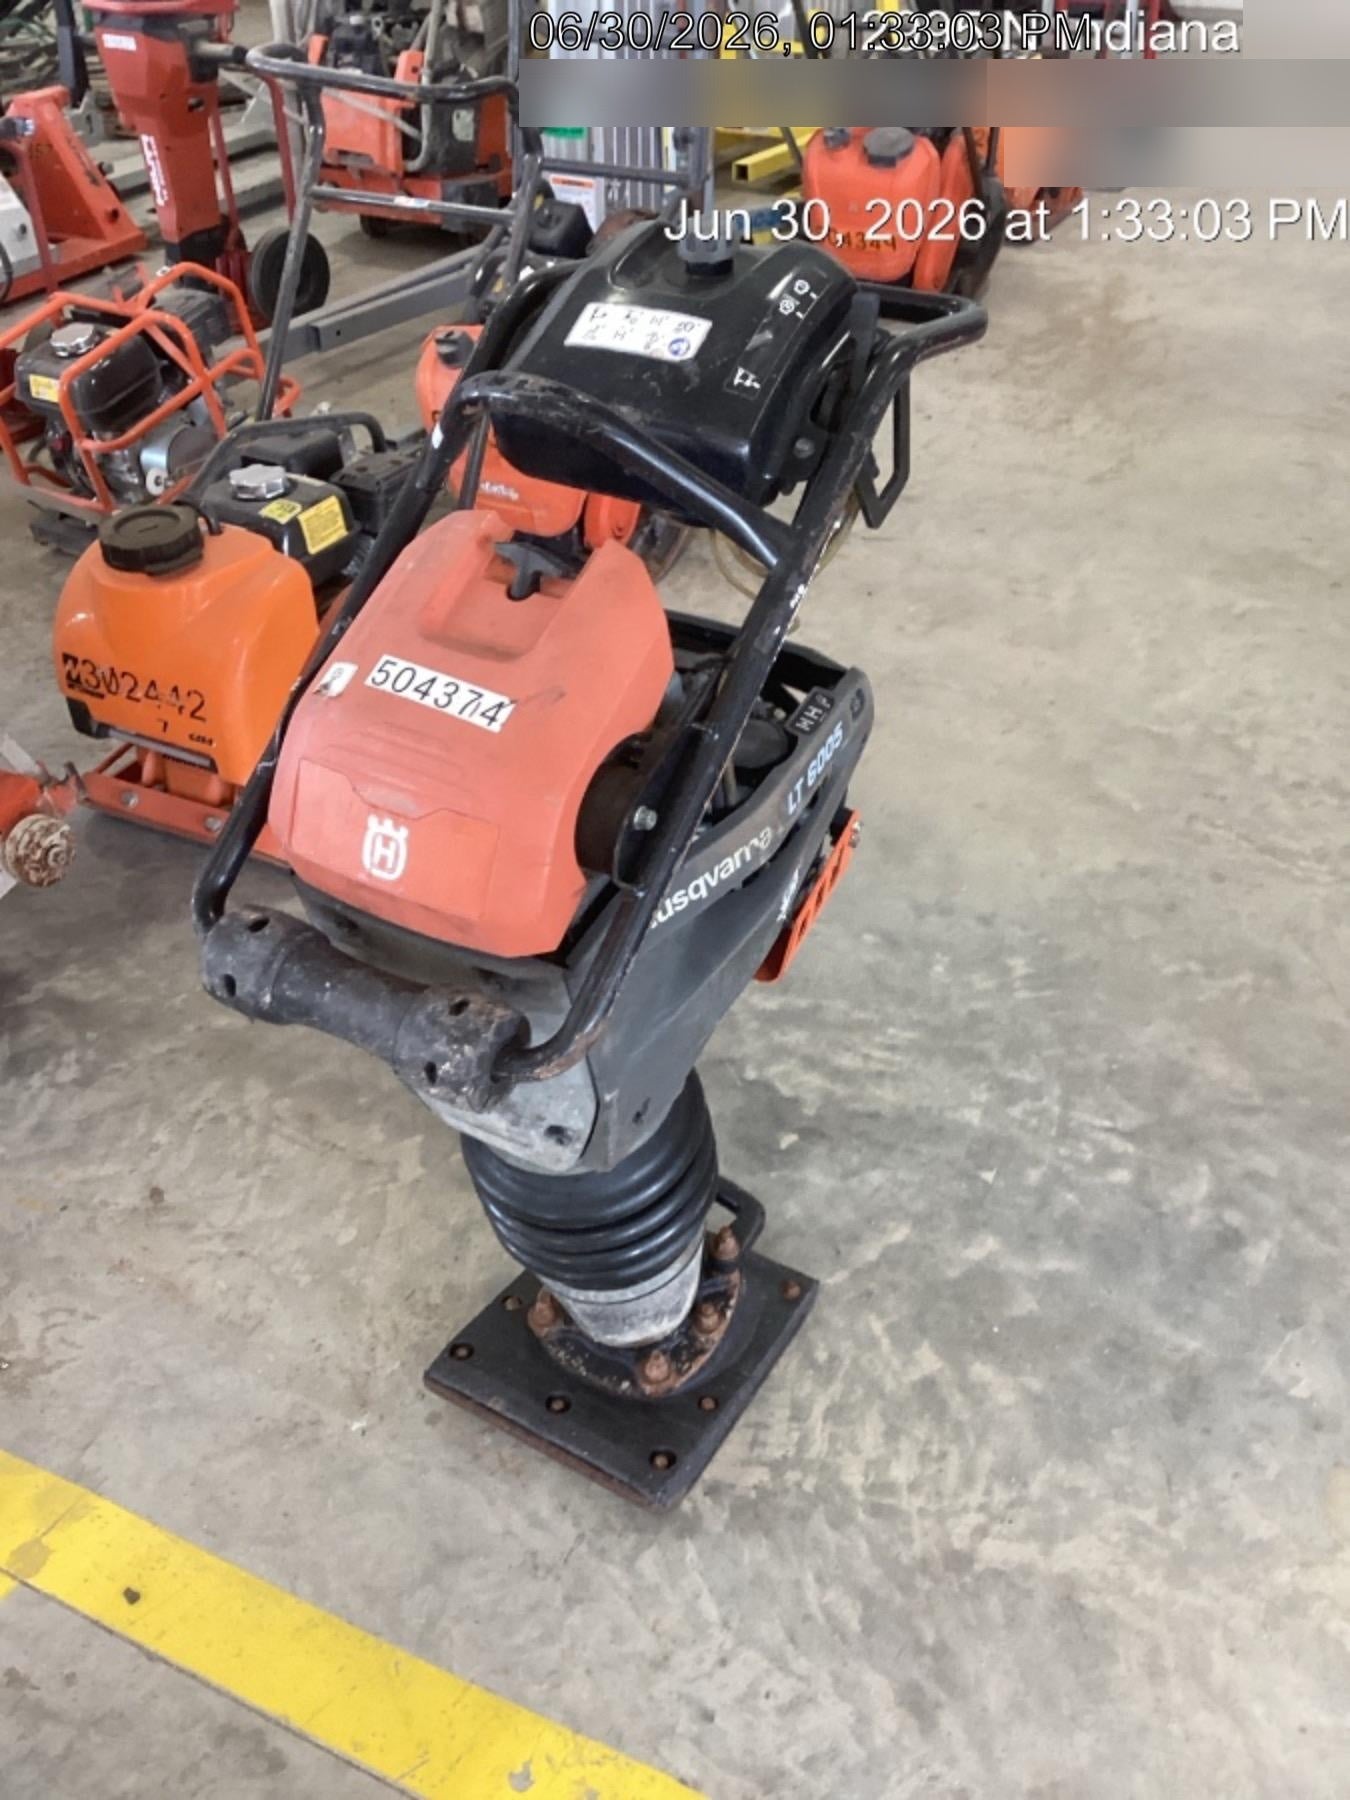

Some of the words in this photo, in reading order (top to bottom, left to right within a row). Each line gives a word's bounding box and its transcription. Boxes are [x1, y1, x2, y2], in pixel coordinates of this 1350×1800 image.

[371, 659, 505, 726] 504374
[787, 776, 805, 815] LT
[650, 825, 774, 929] usqvarna
